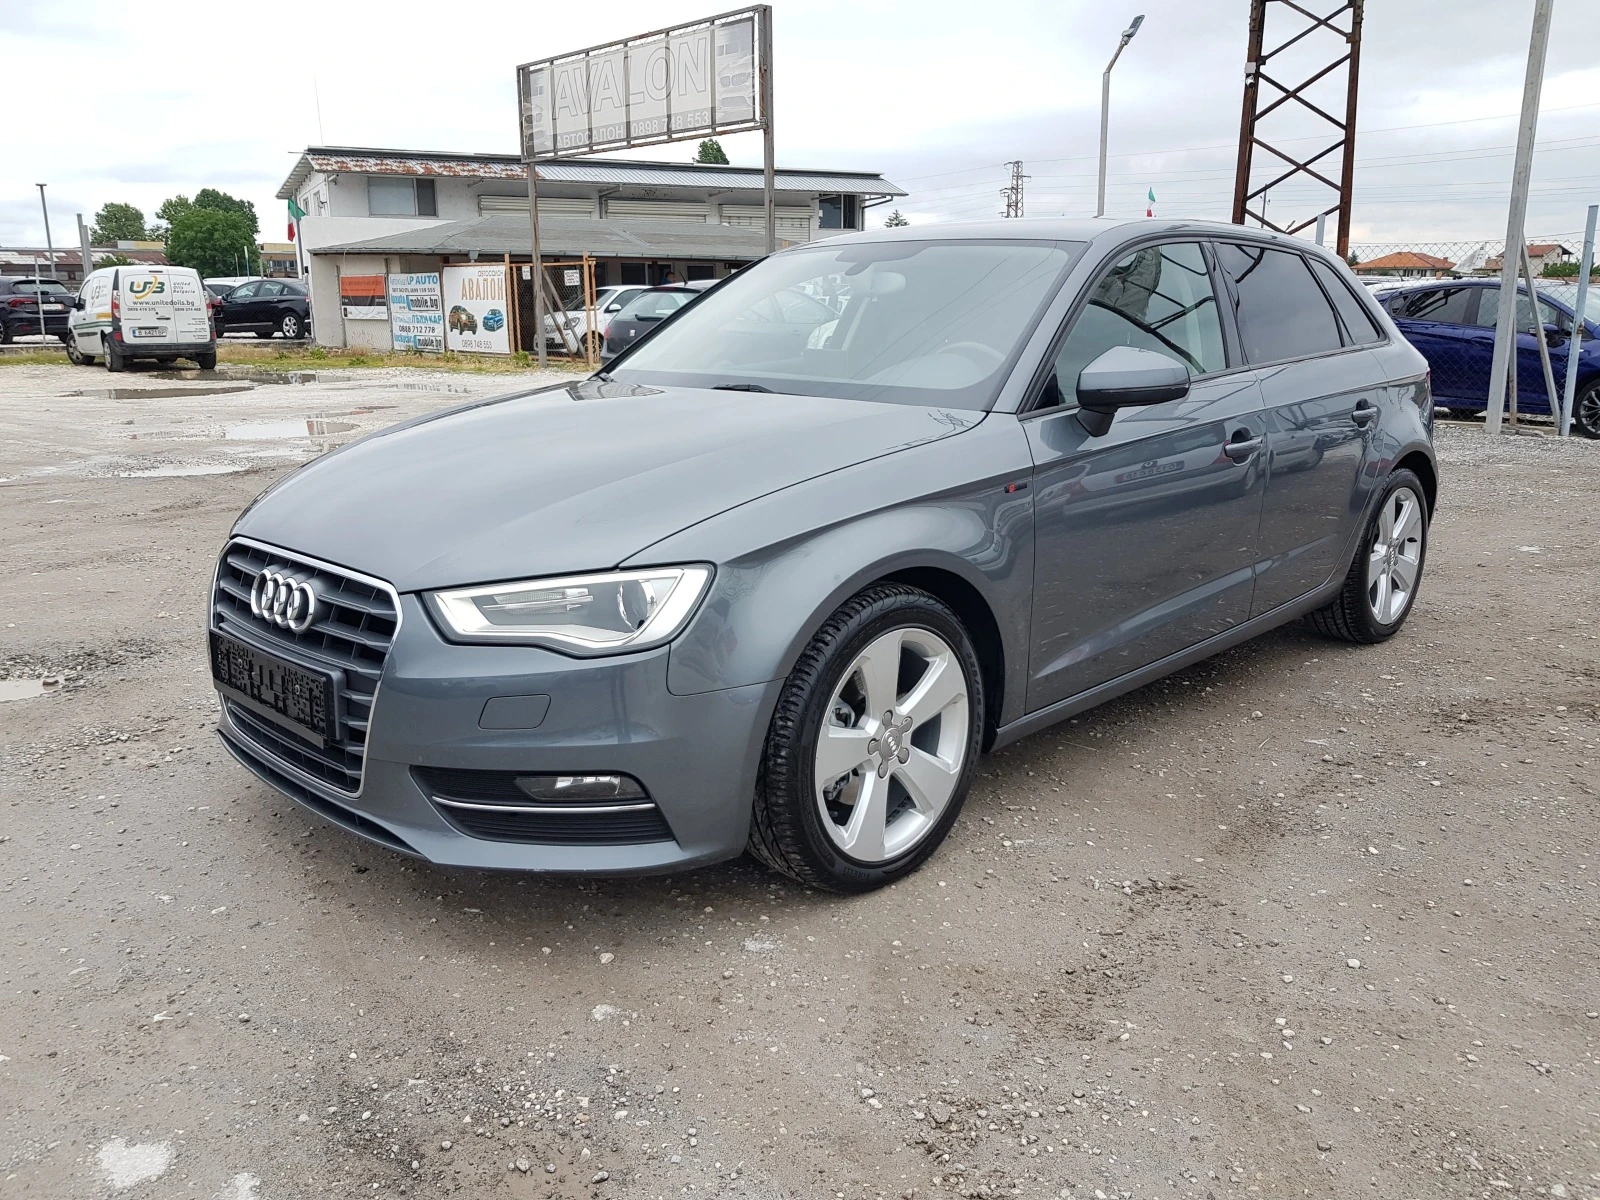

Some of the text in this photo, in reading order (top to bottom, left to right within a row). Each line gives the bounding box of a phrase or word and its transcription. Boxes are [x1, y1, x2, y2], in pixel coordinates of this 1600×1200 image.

[552, 37, 708, 120] AVALON
[556, 125, 624, 149] АВТОСАЛОН
[631, 119, 659, 136] 0898
[687, 110, 711, 127] 553
[415, 275, 438, 285] AUTO
[461, 278, 504, 300] АВАЛОН
[410, 297, 439, 309] mobile.bg
